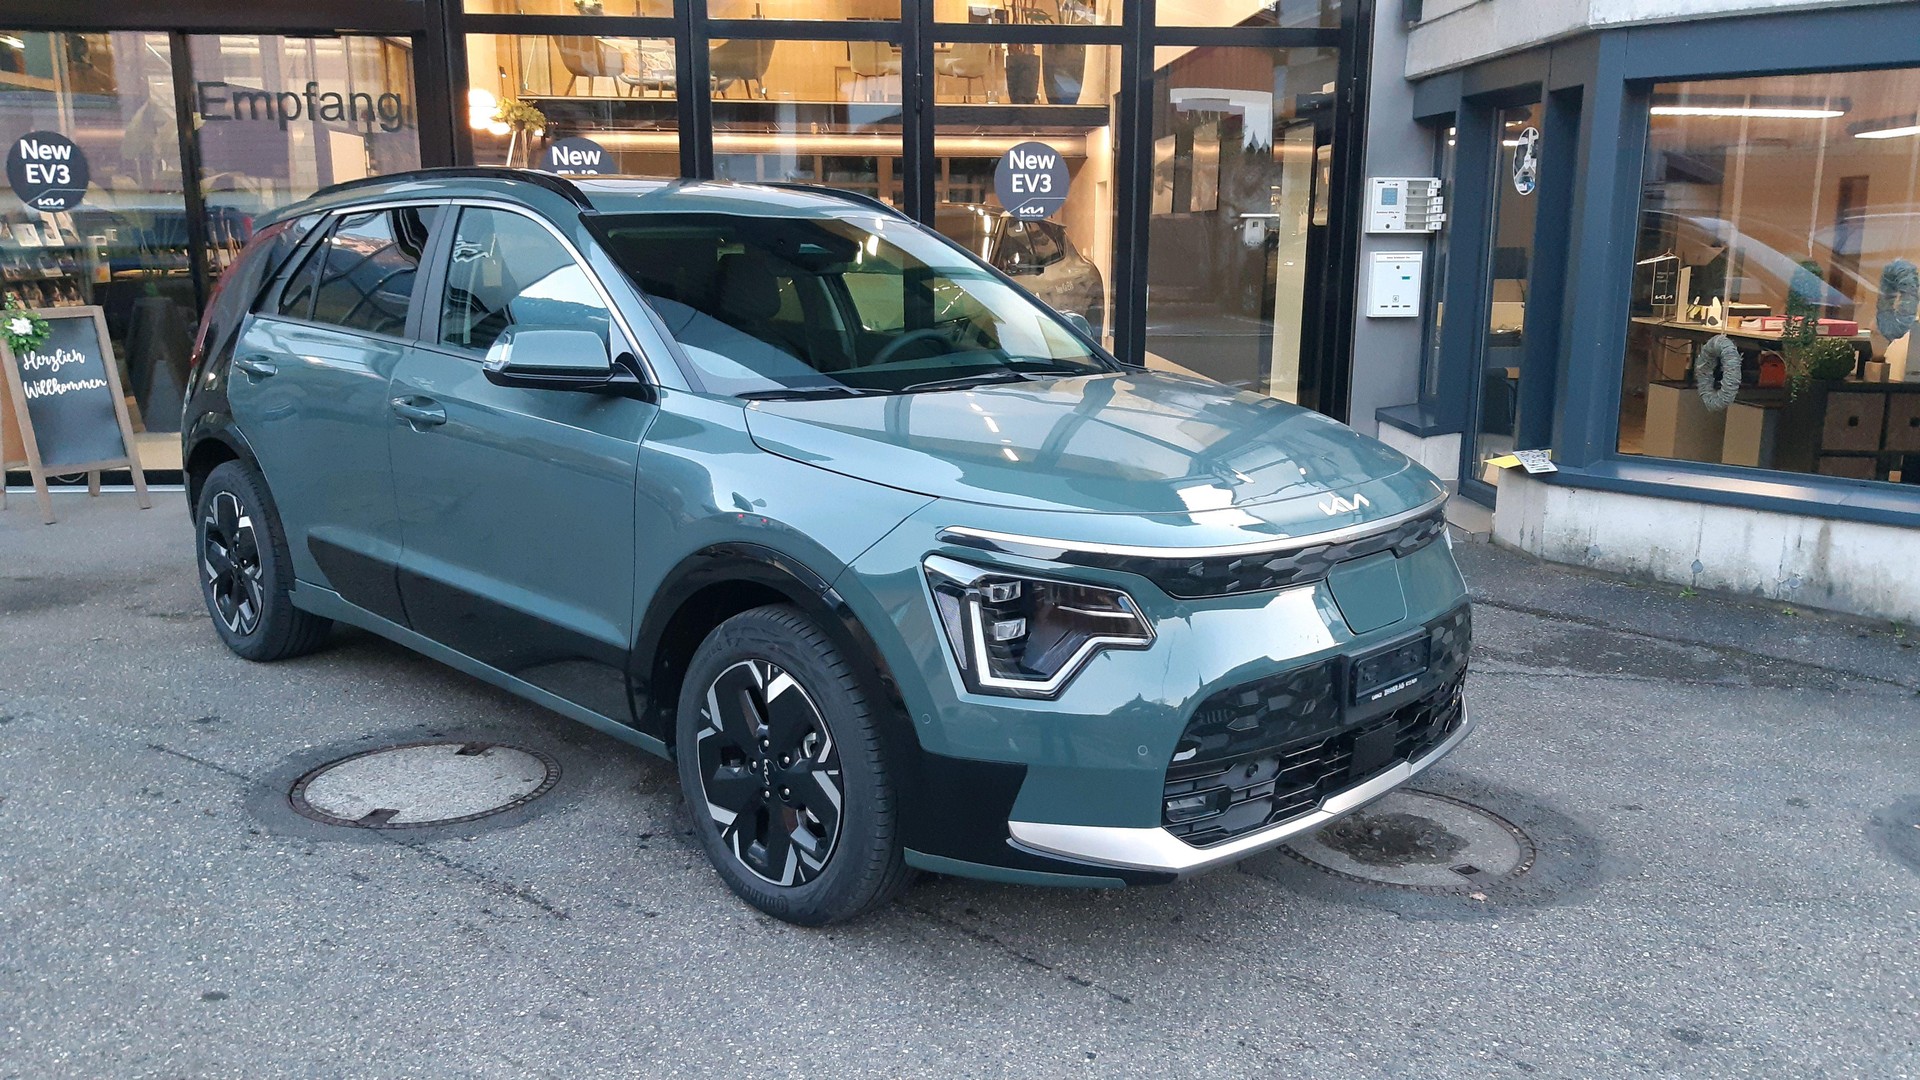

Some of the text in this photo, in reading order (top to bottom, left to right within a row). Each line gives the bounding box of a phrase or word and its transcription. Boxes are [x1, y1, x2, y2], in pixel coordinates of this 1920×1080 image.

[198, 81, 402, 132] Empfang
[20, 139, 71, 160] New
[552, 146, 601, 166] New
[1009, 150, 1056, 170] New
[25, 163, 71, 184] EV3
[1012, 173, 1052, 193] EV3
[23, 348, 86, 372] Herzlich
[23, 378, 107, 399] Willkommen
